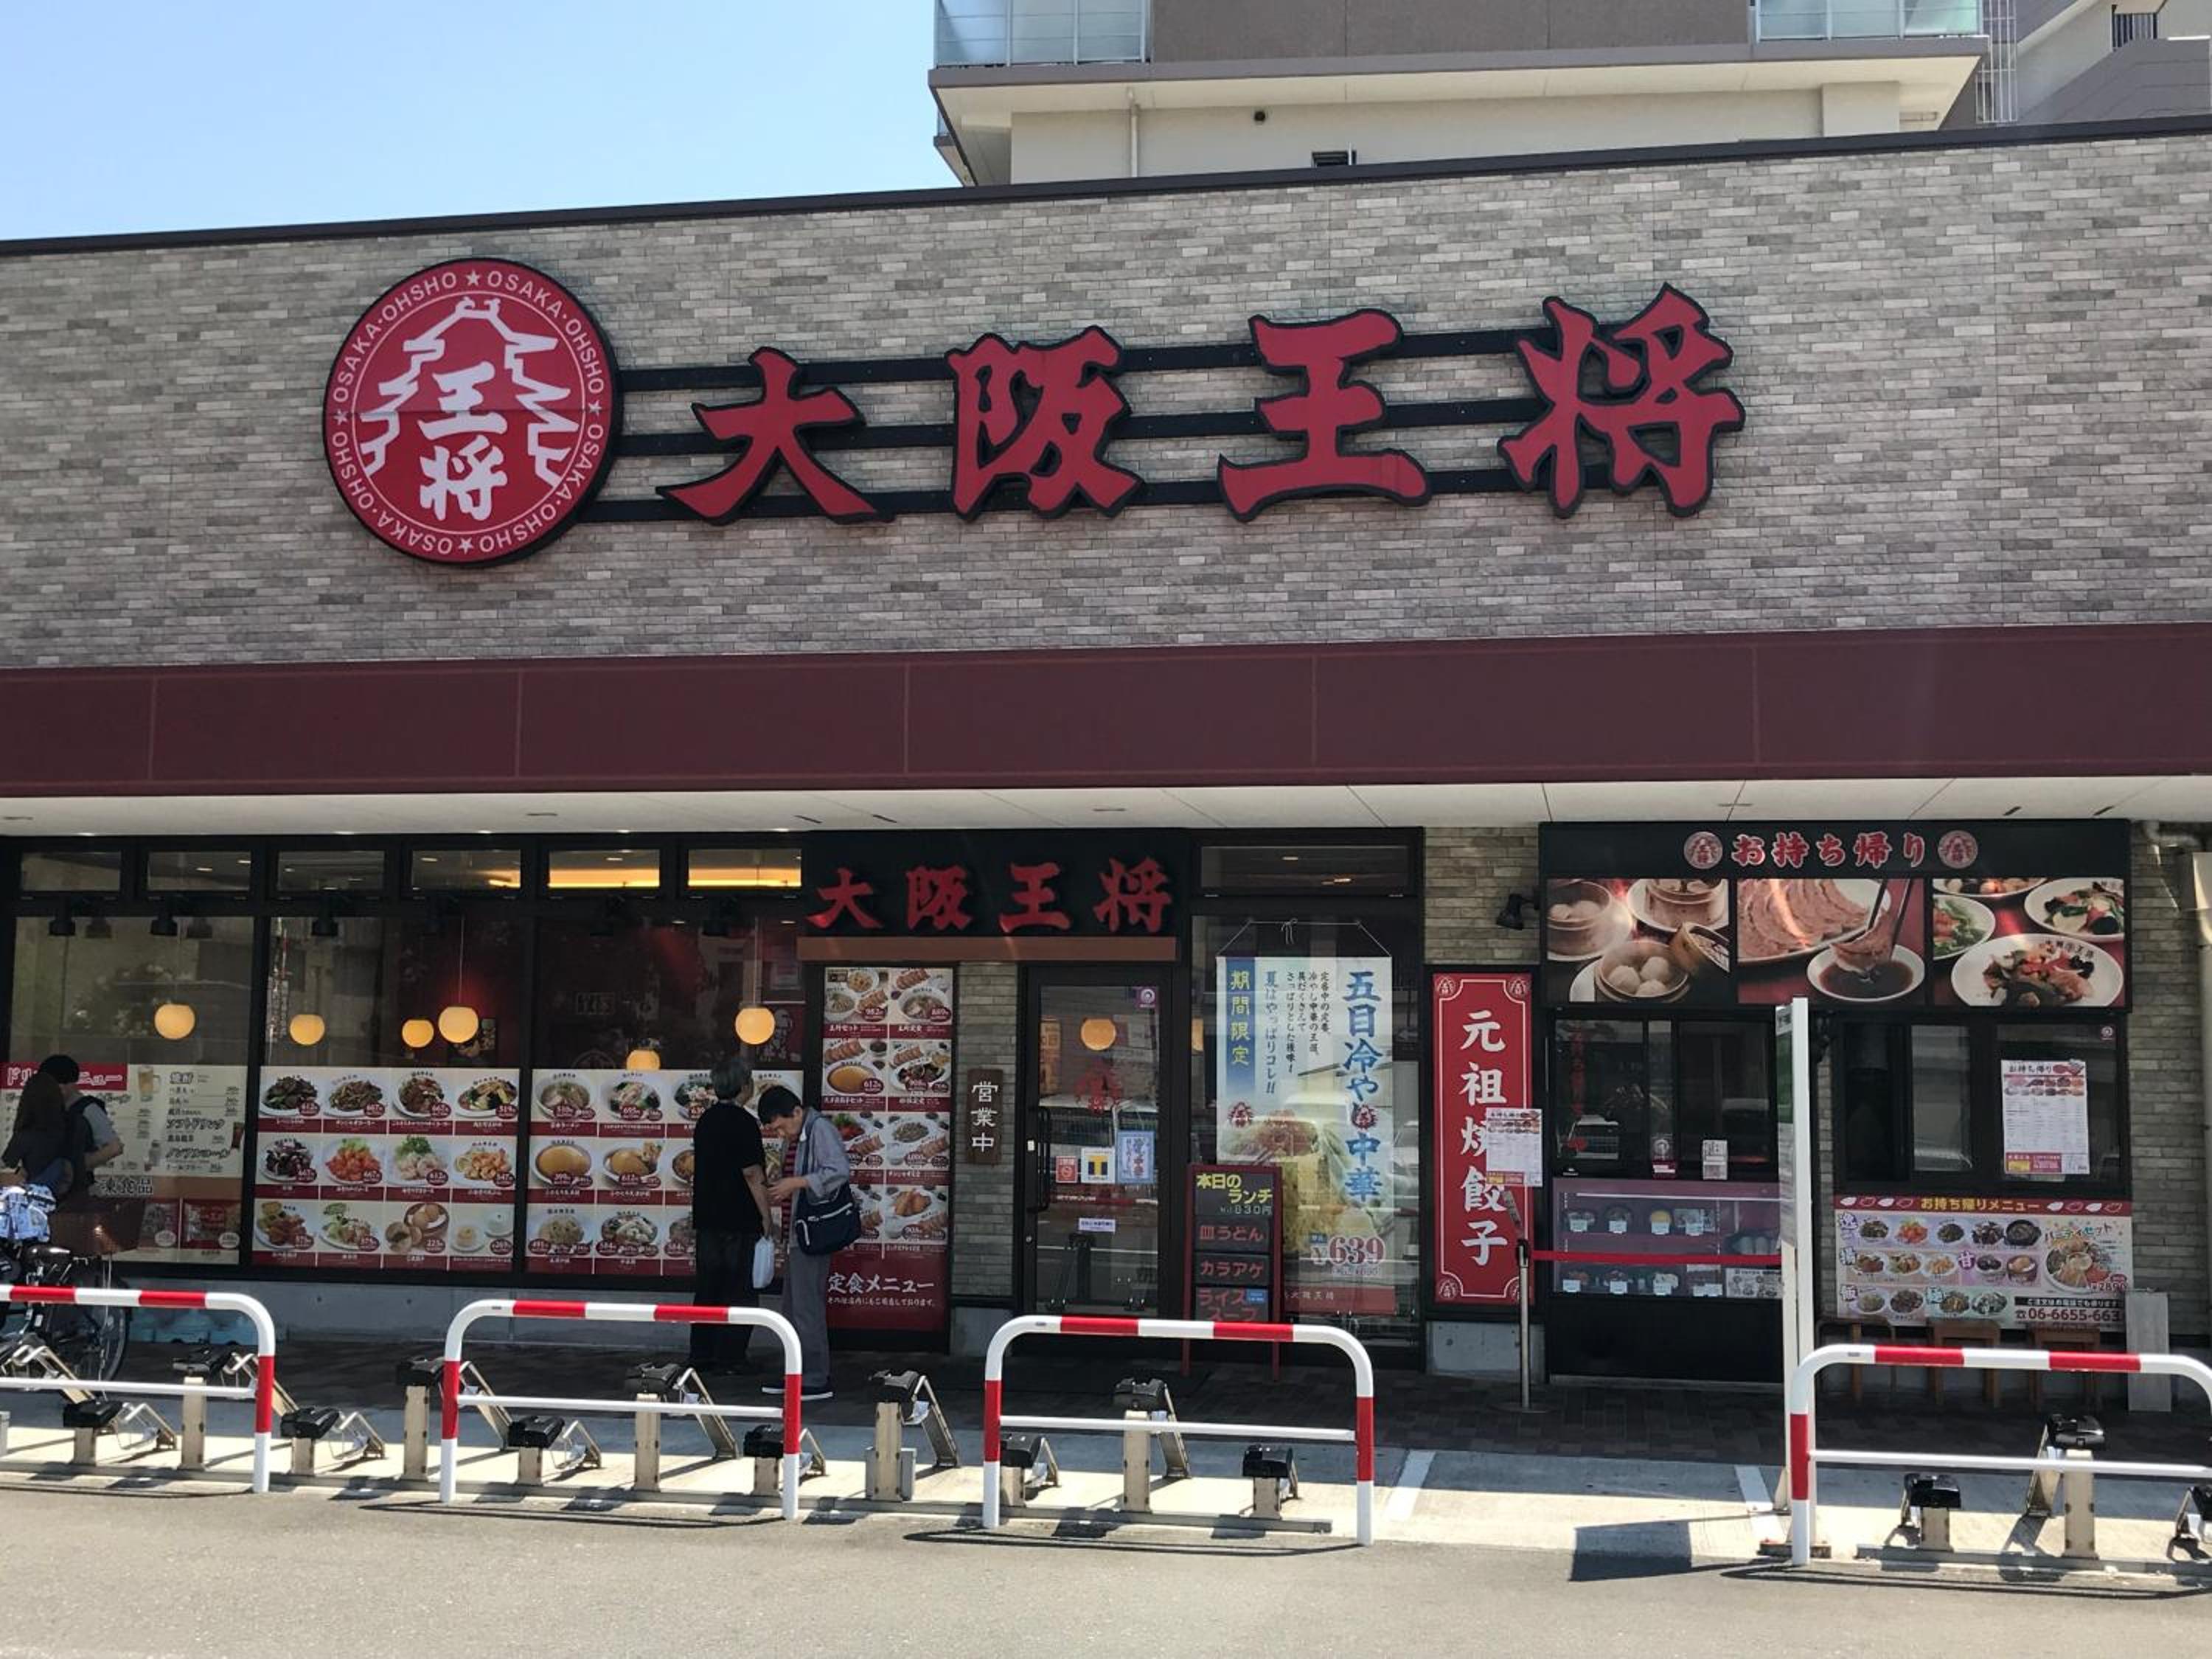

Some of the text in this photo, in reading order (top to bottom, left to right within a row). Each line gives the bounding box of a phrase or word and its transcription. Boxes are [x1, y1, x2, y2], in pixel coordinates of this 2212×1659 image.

[658, 285, 1745, 522] 大阪王将
[417, 360, 508, 521] 王将
[1731, 831, 1925, 869] お持ち帰り
[807, 857, 1172, 933] 大阪王将
[1230, 970, 1251, 1066] 期間限定
[7, 1067, 124, 1086] ドリニュー
[1342, 970, 1383, 1203] 五目冷やし中華
[970, 1080, 999, 1152] 営業中
[1196, 1174, 1242, 1189] 本日の
[1228, 1189, 1273, 1205] ランチ
[1920, 1197, 2040, 1211] お持ち帰りメニュー
[1200, 1225, 1265, 1242] 皿うどん
[1200, 1261, 1264, 1279] カラアゲ
[1960, 1251, 1975, 1270] 甘
[828, 1272, 934, 1294] 定食メニュー
[1199, 1289, 1246, 1306] ライス
[2028, 1307, 2124, 1322] 06-6655-663
